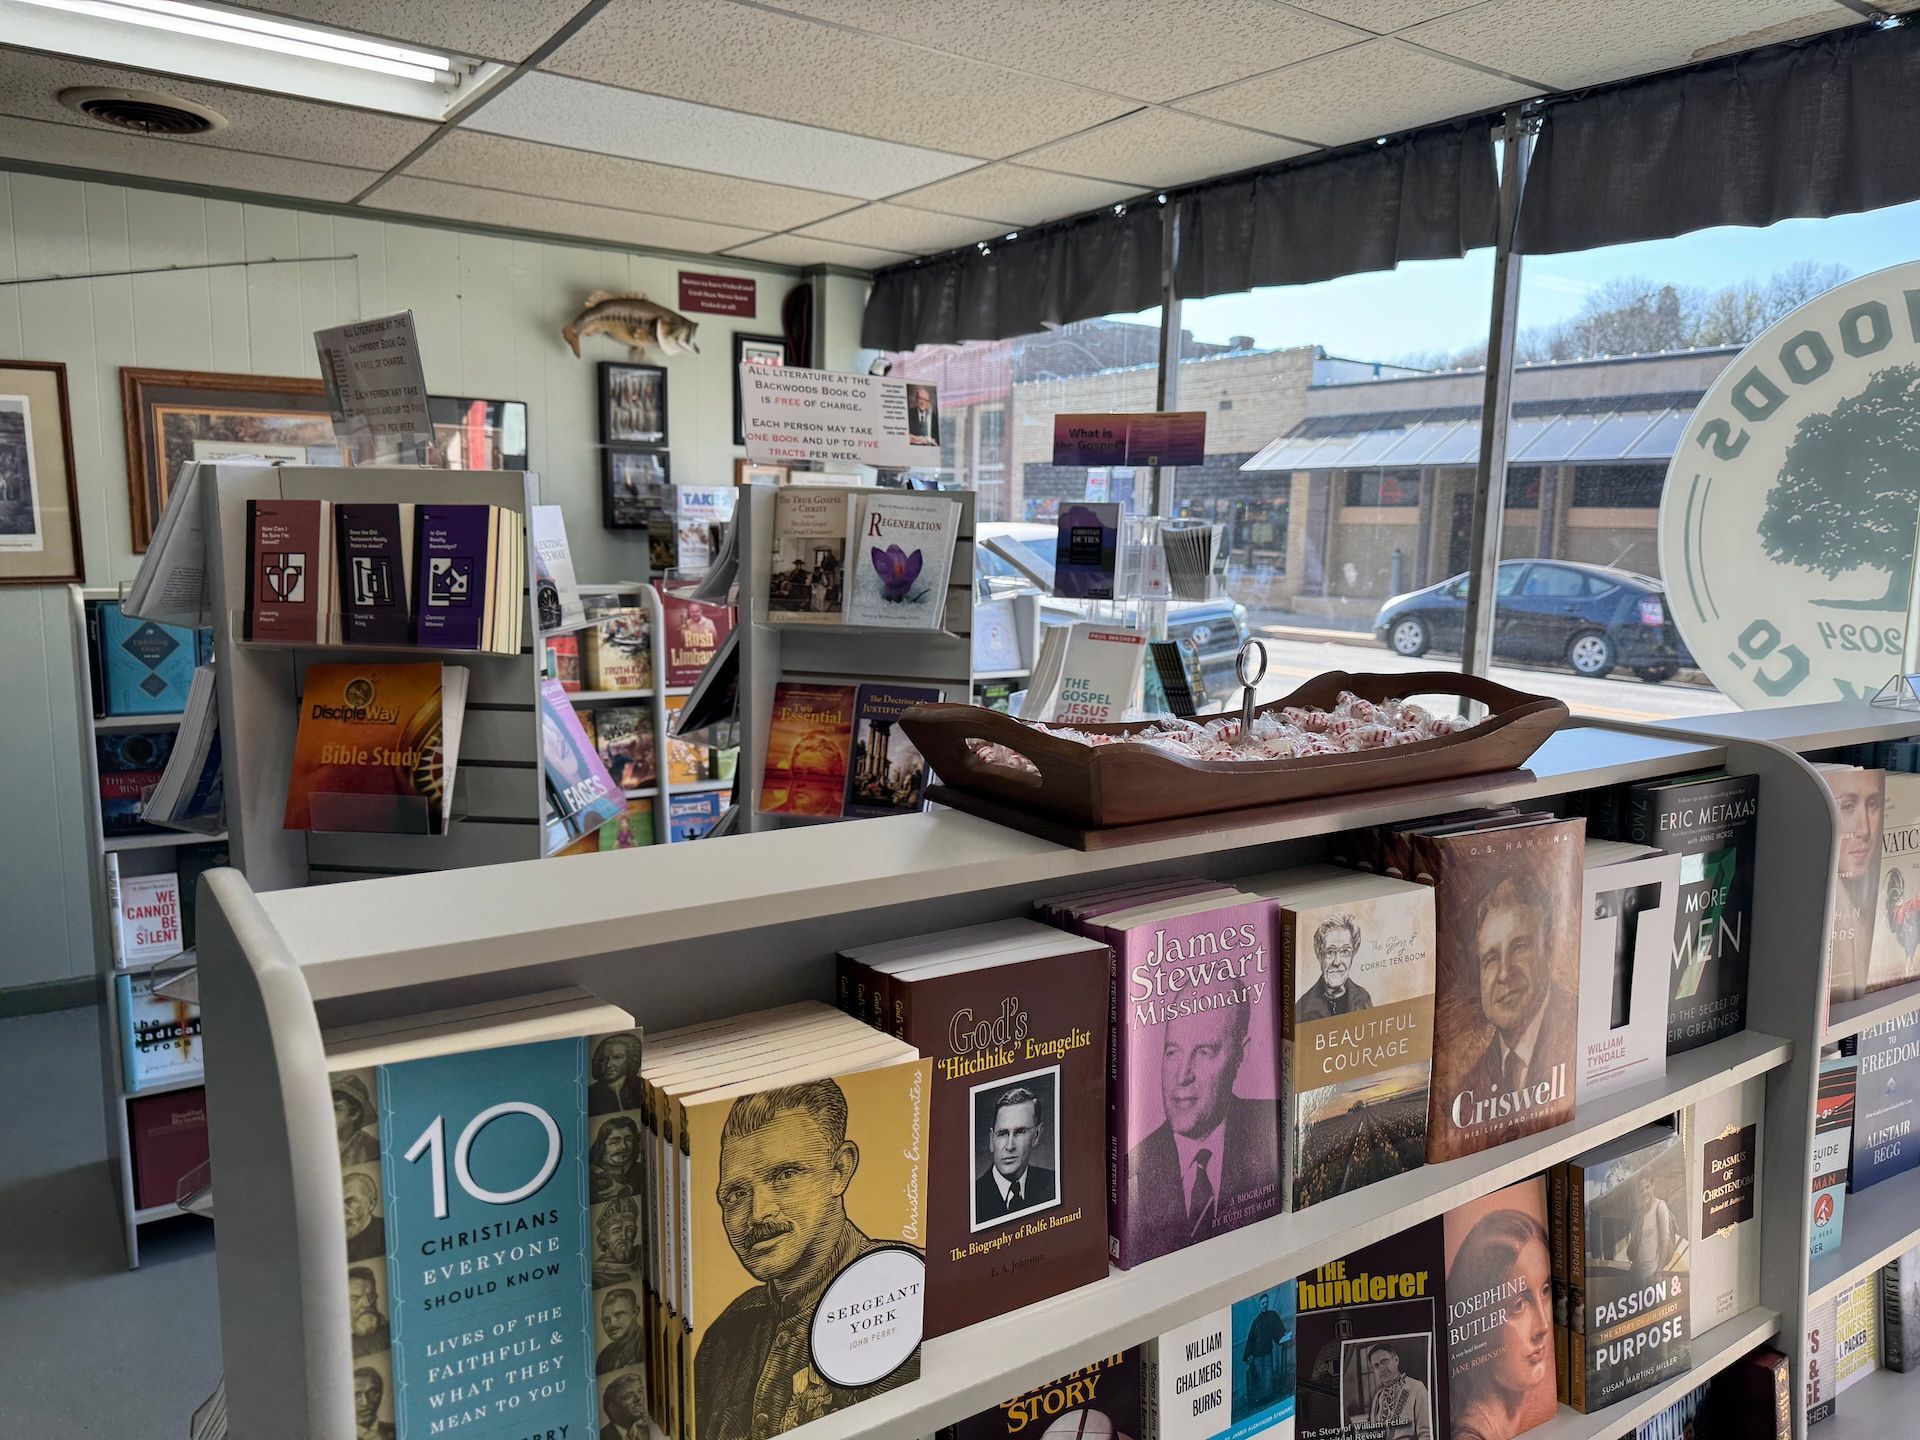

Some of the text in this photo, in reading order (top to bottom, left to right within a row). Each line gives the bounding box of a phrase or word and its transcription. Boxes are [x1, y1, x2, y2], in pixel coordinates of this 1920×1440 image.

[748, 366, 870, 385] ALL LITERATURE AT THE
[755, 381, 818, 394] BACKWOODS
[822, 387, 849, 398] BOOK
[775, 397, 800, 407] FREE
[820, 401, 862, 412] CHARGE.
[752, 418, 873, 435] EACH PERSON MAY TAKE
[1069, 428, 1112, 438] What is
[747, 433, 879, 449] ONE BOOK AND UP TO FIVE
[769, 448, 861, 461] TRACTS PER WEEK.
[814, 496, 841, 504] GOSPEL
[868, 512, 942, 536] REGENERATION
[684, 632, 714, 647] Rush
[1090, 632, 1106, 640] PAUL
[1062, 690, 1112, 705] GOSPEL
[1065, 678, 1090, 689] THE
[793, 703, 813, 713] Two
[870, 695, 914, 705] The Doctrine
[1066, 704, 1109, 717] JESUS
[781, 707, 842, 724] Essential
[321, 745, 422, 771] Bible Study
[564, 775, 608, 813] FACES
[1660, 809, 1694, 832] ERIC
[1699, 798, 1756, 826] METAXAS
[1471, 834, 1569, 855] O. S. HAWKINS
[1700, 832, 1716, 843] ANNE
[1717, 829, 1734, 840] MORSE
[156, 890, 175, 903] WE
[1685, 886, 1727, 914] MORE
[127, 903, 176, 920] CANNOT
[162, 917, 177, 928] BE
[1147, 923, 1256, 968] James
[1672, 911, 1742, 970] MEN
[1130, 946, 1267, 1003] Stewart
[1360, 951, 1426, 972] CORRIE TEN BOOM
[1131, 981, 1266, 1032] Missionary
[1680, 1000, 1728, 1023] THE SECRET
[135, 1023, 200, 1042] Radical
[949, 996, 1029, 1056] God's
[1315, 1012, 1416, 1051] BEAUTIFUL
[1686, 1010, 1739, 1039] GREATNESS
[141, 1038, 192, 1053] Cross
[1025, 1028, 1092, 1061] Evangelist
[1323, 1038, 1409, 1074] COURAGE
[1587, 1047, 1626, 1067] TYNDALE
[1588, 1036, 1623, 1056] WILLIAM
[1861, 1040, 1920, 1075] FREEDOM
[1451, 1063, 1566, 1130] Criswell
[1465, 1106, 1555, 1140] HIS LIFE AND TIMES
[1866, 1119, 1911, 1150] ALISTAIR
[403, 1101, 563, 1220] 10
[901, 1069, 923, 1241] Christian Encounters
[1711, 1150, 1746, 1175] ERASMUS
[1874, 1141, 1901, 1165] BEGG
[1703, 1174, 1754, 1204] CHRISTENDOM
[1723, 1169, 1733, 1182] OF
[1237, 1183, 1276, 1205] BIOGRAPHY
[1223, 1197, 1276, 1225] RUTH STEWART
[420, 1209, 560, 1257] CHRISTIANS
[950, 1207, 1082, 1262] The Biography of Rolfe Barnard
[423, 1236, 561, 1286] EVERYONE
[1010, 1253, 1046, 1271] Johnston
[1317, 1260, 1346, 1282] THE
[424, 1263, 561, 1311] SHOULD KNOW
[1296, 1270, 1428, 1310] hunderer
[1448, 1275, 1527, 1326] JOSEPHINE
[826, 1282, 920, 1324] SERGEANT
[1595, 1275, 1682, 1328] PASSION &
[426, 1305, 563, 1358] LIVES OF THE
[850, 1309, 898, 1334] YORK
[1449, 1308, 1509, 1346] BUTLER
[1599, 1303, 1678, 1341] THE STORY ELLIOT
[849, 1326, 897, 1351] JOHN PERRY
[1185, 1331, 1223, 1362] WILLIAM
[1595, 1315, 1683, 1372] PURPOSE
[1844, 1330, 1867, 1355] PACKER
[427, 1329, 563, 1383] FAITHFUL &
[1452, 1344, 1508, 1377] JANE ROBINSON
[429, 1355, 565, 1409] WHAT THEY
[1176, 1360, 1222, 1395] CHALMERS
[1601, 1355, 1678, 1395] SUSAN MARTINS MILLER
[430, 1380, 567, 1435] MEAN TO YOU
[1007, 1374, 1101, 1434] STORY
[1192, 1389, 1222, 1417] BURNS
[1301, 1430, 1316, 1439] The
[1319, 1426, 1341, 1436] Story
[1344, 1424, 1352, 1432] of
[1354, 1421, 1382, 1430] William
